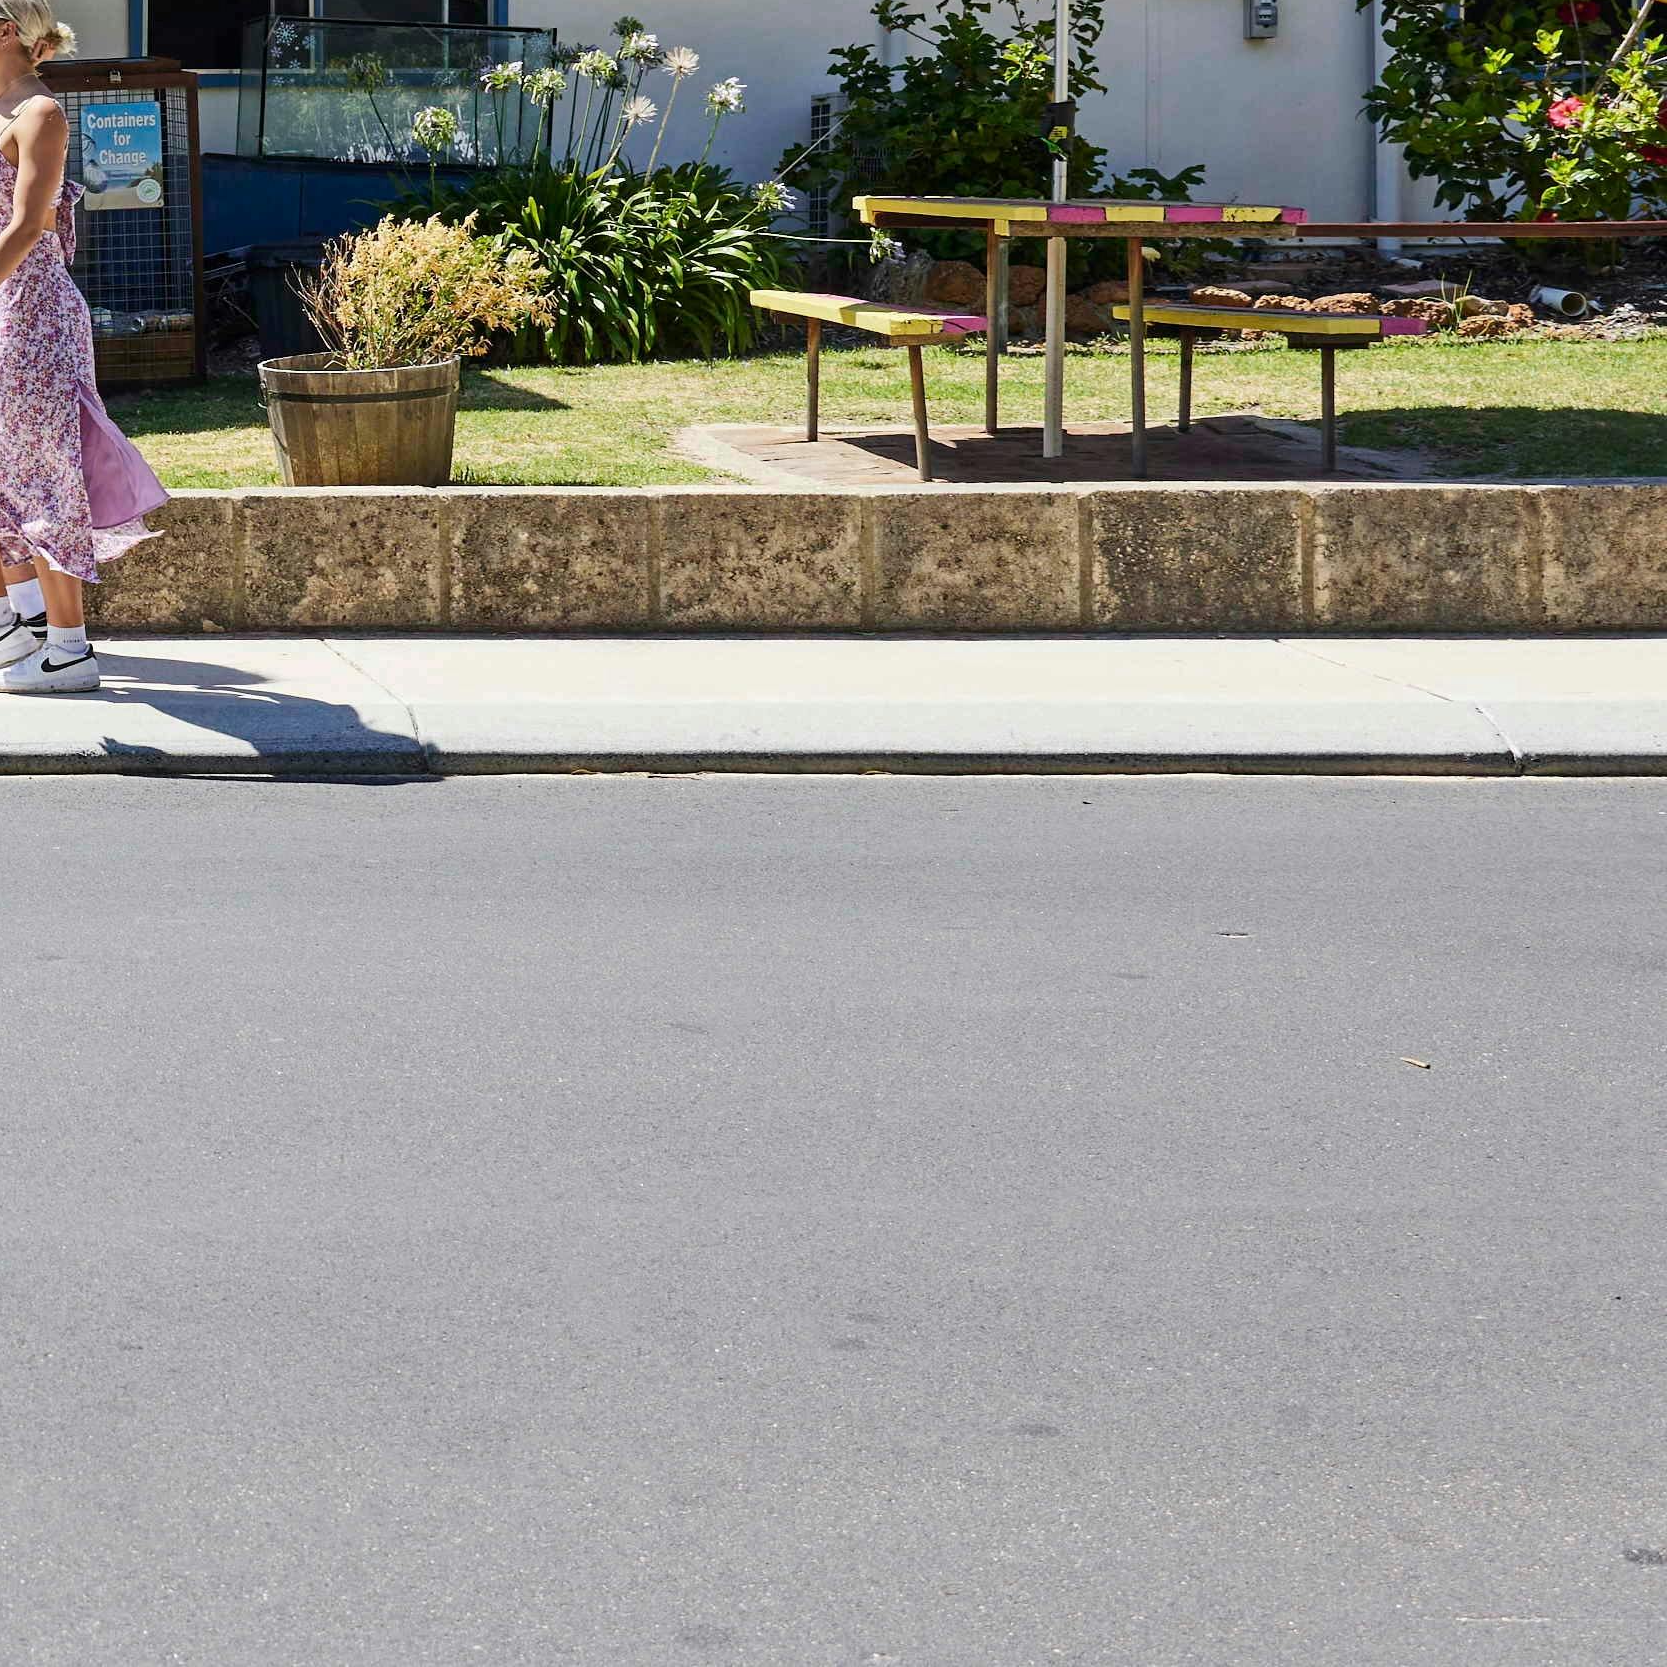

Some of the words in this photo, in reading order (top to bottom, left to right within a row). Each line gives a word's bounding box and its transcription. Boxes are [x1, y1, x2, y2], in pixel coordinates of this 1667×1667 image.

[87, 112, 156, 129] Containers
[113, 131, 131, 146] for
[99, 149, 147, 166] Change
